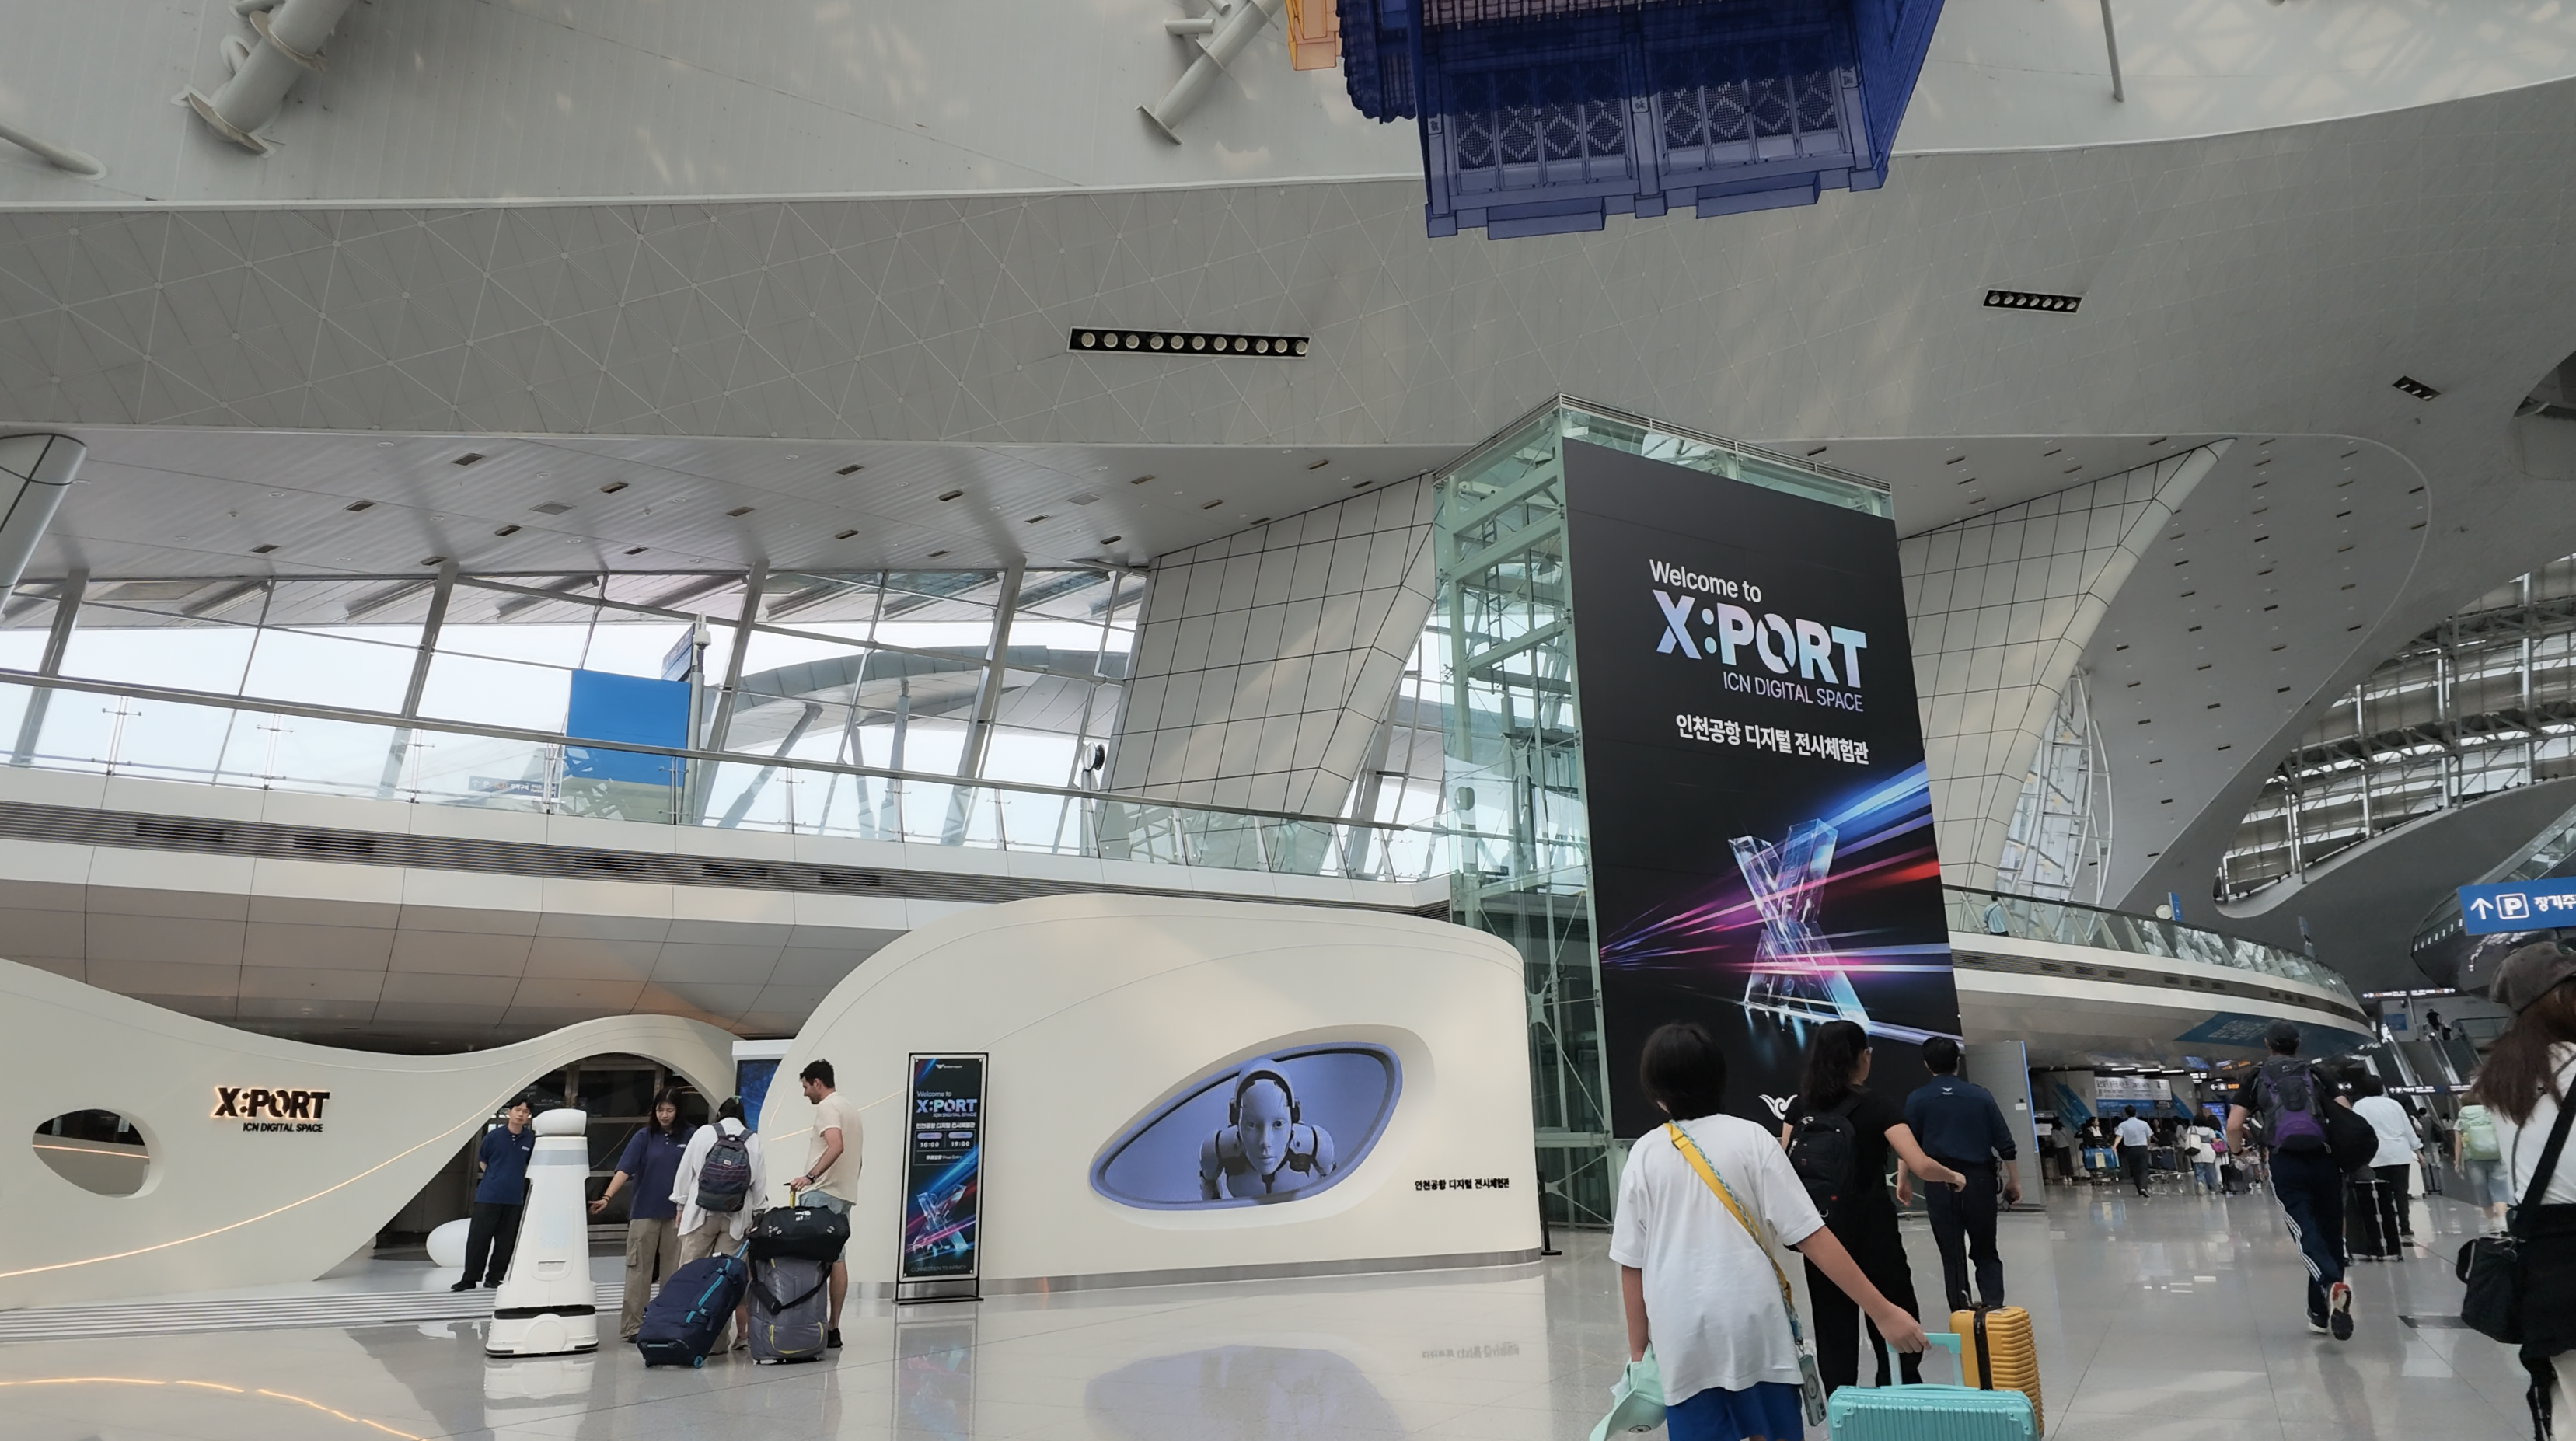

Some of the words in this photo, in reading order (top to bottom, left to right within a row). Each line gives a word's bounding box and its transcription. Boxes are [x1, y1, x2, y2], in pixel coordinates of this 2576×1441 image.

[1649, 559, 1738, 598] Welcome
[1742, 581, 1761, 603] to
[1652, 589, 1867, 688] X:PORT
[1723, 671, 1750, 693] ICN
[1755, 677, 1813, 704] DIGITAL
[1817, 688, 1863, 712] SPACE
[1676, 714, 1741, 746] 인천공항
[1744, 724, 1792, 754] 디지털
[1794, 732, 1869, 765] 전시체험관
[214, 1087, 330, 1118] X:PORT
[916, 1098, 978, 1113] X:PORT
[243, 1122, 260, 1132] ICN
[260, 1122, 294, 1132] DIGITAL
[296, 1123, 323, 1132] SPACE
[1449, 1178, 1472, 1189] 디지털
